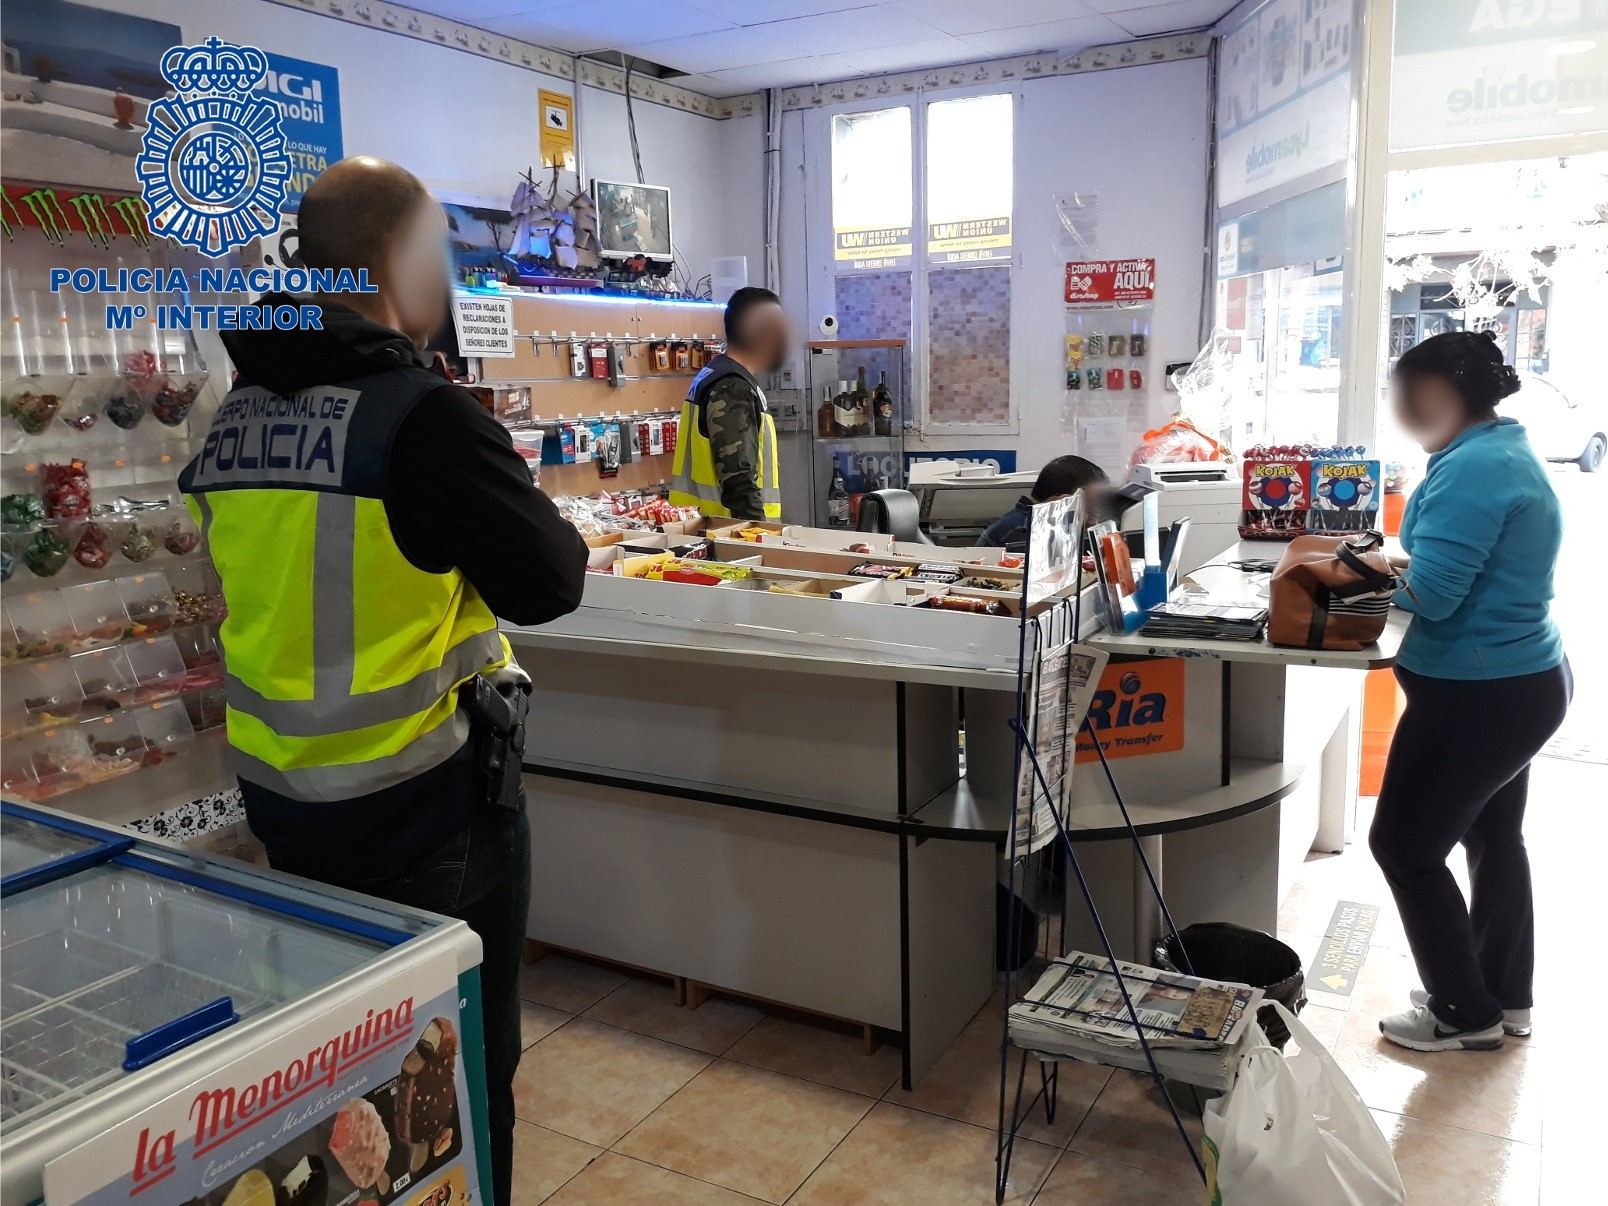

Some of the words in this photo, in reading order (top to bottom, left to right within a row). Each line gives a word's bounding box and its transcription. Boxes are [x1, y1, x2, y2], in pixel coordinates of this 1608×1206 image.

[287, 141, 297, 150] LO
[298, 142, 312, 152] QUE
[313, 145, 327, 154] HAY
[1071, 263, 1107, 274] COMPRA
[1109, 263, 1115, 273] Y
[460, 302, 483, 311] EXISTEN
[483, 303, 498, 312] HOJAS
[498, 304, 506, 312] DE
[462, 314, 501, 323] RECLAMACIONES
[491, 327, 498, 335] DE
[498, 327, 509, 336] LOS
[485, 339, 508, 348] CLIENTES
[250, 395, 316, 418] NACIONAL
[320, 395, 349, 419] DE
[200, 423, 335, 475] POLICIA
[1255, 464, 1297, 478] KOJAK
[1322, 464, 1368, 479] KOJAK
[1084, 688, 1167, 732] Ria
[1114, 733, 1164, 747] Transfer
[1337, 907, 1358, 928] PASOS
[1324, 927, 1351, 963] SENCILLOS
[1341, 954, 1361, 972] PARA
[132, 1127, 177, 1183] la
[189, 995, 414, 1147] Menorquina
